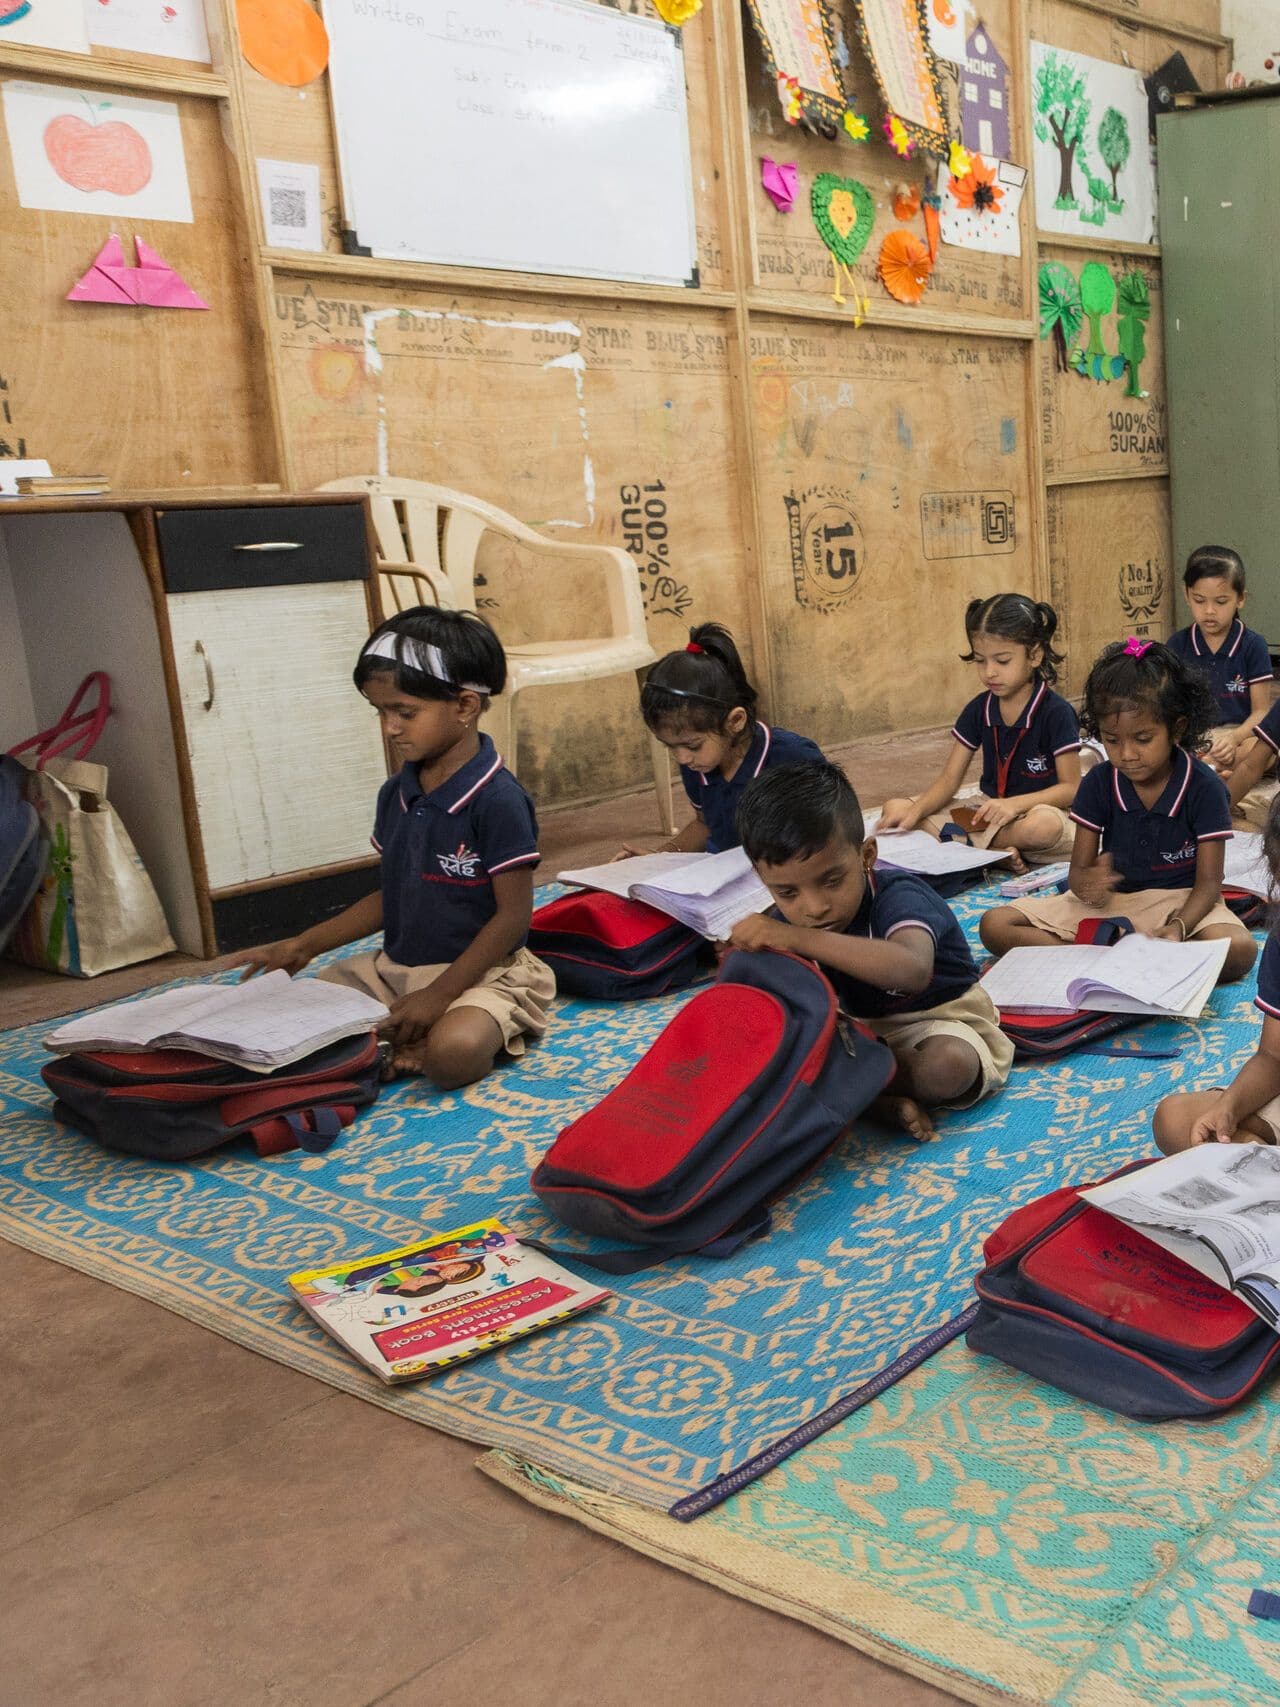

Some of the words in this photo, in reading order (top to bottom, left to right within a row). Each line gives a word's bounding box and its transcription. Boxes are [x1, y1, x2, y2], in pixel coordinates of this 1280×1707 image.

[964, 57, 998, 79] HOME
[400, 341, 445, 354] PLYWOOD
[646, 330, 690, 353] BLUE
[749, 337, 785, 357] BLUE
[790, 339, 826, 358] STAR
[1107, 410, 1147, 434] 100%
[1109, 434, 1166, 454] GURJAN
[644, 478, 671, 576] 100%
[811, 527, 825, 576] Years
[823, 521, 857, 581] 15
[1127, 559, 1153, 583] No.1
[1128, 584, 1154, 597] QUALITY
[1136, 625, 1149, 635] MR
[436, 853, 482, 878] स्नेह
[425, 1290, 475, 1312] Nursery
[437, 1285, 553, 1333] Assessment
[401, 1316, 440, 1334] Series
[448, 1310, 516, 1339] Firefly
[384, 1327, 436, 1351] Book
